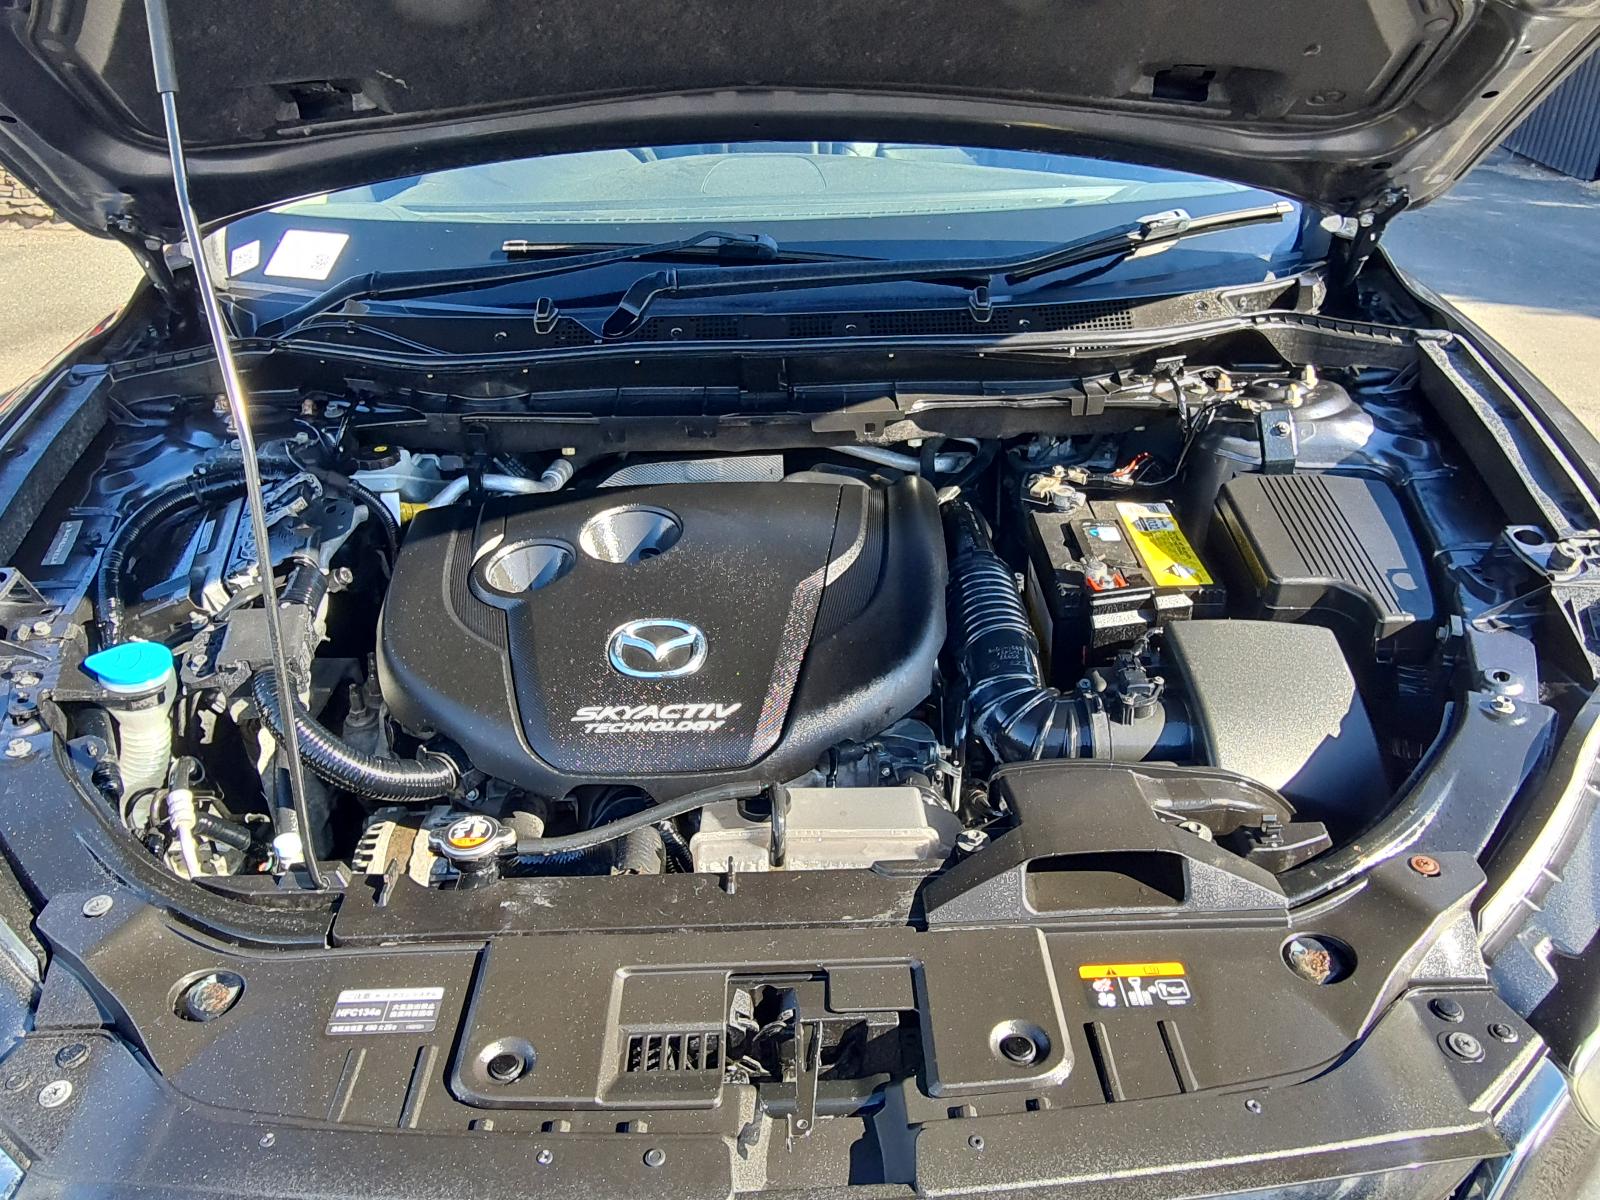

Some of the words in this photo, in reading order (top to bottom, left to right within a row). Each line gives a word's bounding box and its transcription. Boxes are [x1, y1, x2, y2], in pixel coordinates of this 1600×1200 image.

[571, 703, 742, 721] SKYACTIV
[584, 720, 726, 734] TECHNOLOGY
[335, 1008, 382, 1018] HFC134a
